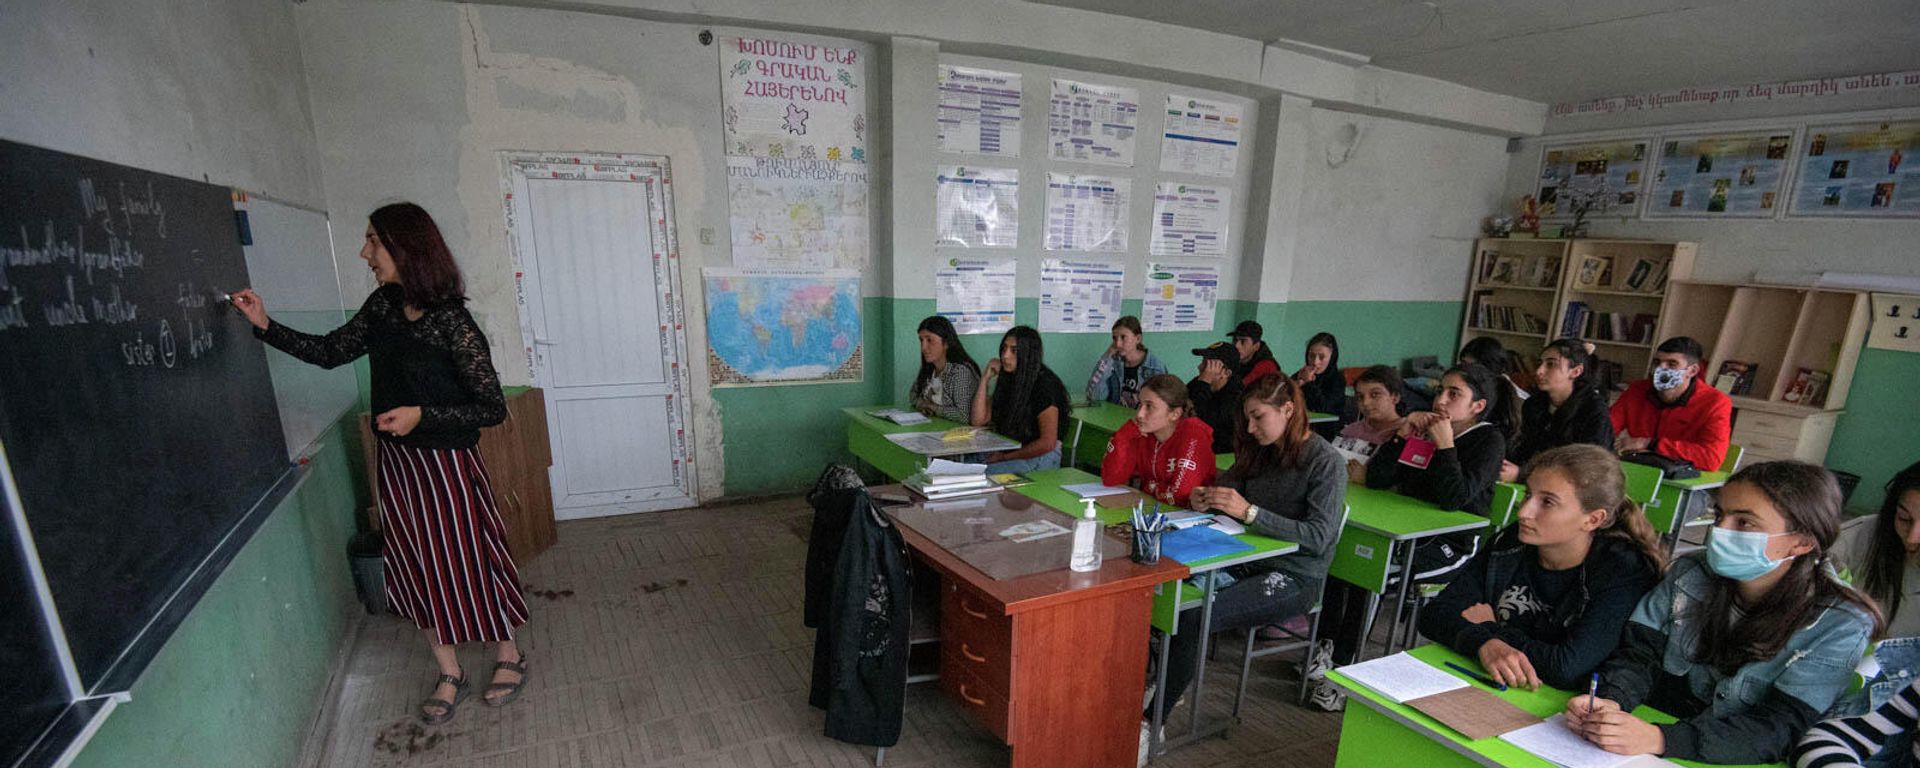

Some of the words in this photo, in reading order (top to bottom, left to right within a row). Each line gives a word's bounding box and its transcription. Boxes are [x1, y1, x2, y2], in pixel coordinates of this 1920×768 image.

[737, 37, 817, 61] ԽՈՍՈՒՄ
[823, 47, 857, 64] ԵՆՔ
[756, 59, 832, 82] ԳՐԱԿԱՆ
[744, 80, 848, 106] ՀԱՅԵՐԵՆՈՎ
[1778, 77, 1838, 97] մարդիկ
[78, 178, 114, 235] My
[120, 181, 166, 238] family
